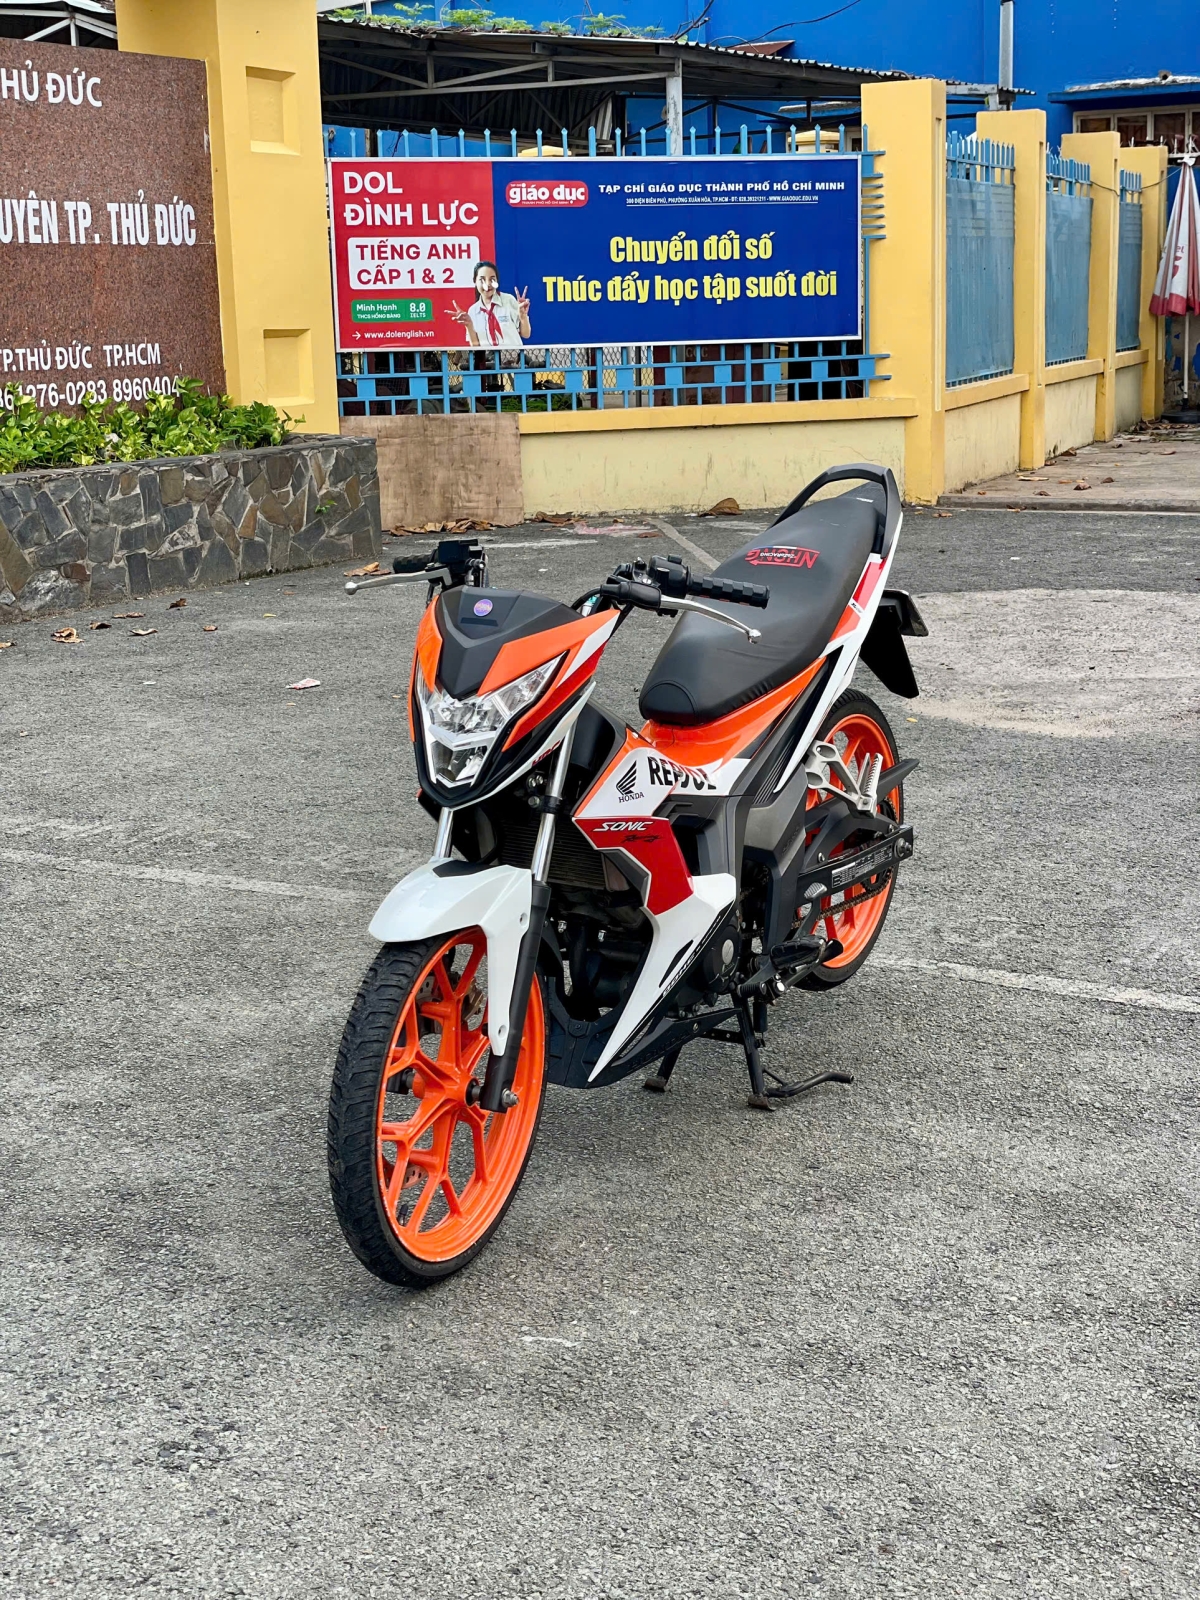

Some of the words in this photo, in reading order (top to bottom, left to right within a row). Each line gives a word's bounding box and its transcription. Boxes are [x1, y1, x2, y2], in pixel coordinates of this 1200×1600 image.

[0, 60, 39, 102] HỦ
[46, 67, 102, 108] ĐỨC
[343, 171, 403, 194] DOL
[509, 182, 550, 204] giáo
[552, 184, 585, 204] dục
[599, 184, 621, 195] TẠP
[624, 183, 644, 192] CHÍ
[648, 183, 675, 192] GIÁO
[679, 184, 702, 194] DỤC
[706, 182, 742, 191] THÀNH
[747, 180, 770, 191] PHỐ
[773, 180, 788, 190] HỒ
[792, 180, 812, 190] CHÍ
[816, 182, 844, 190] MINH
[0, 190, 58, 244] UYÊN
[64, 201, 100, 244] TP.
[107, 189, 149, 246] THỦ
[155, 195, 196, 246] ĐỨC
[344, 198, 413, 226] ĐÌNH
[422, 200, 479, 230] LỰC
[356, 239, 421, 260] TIẾNG
[427, 243, 471, 260] ANH
[610, 232, 697, 264] Chuyển
[704, 230, 740, 260] đổi
[746, 231, 775, 259] số
[357, 262, 401, 285] CẤP
[407, 269, 415, 284] 1
[422, 269, 435, 284] &
[442, 268, 454, 284] 2
[543, 275, 602, 302] Thúc
[608, 271, 649, 304] đẩy
[655, 275, 698, 306] học
[704, 272, 740, 305] tập
[746, 270, 796, 298] suốt
[802, 270, 837, 296] đời
[377, 304, 397, 312] Hạnh
[410, 302, 426, 312] 8.0
[364, 330, 434, 339] www.dolenglish.vn
[0, 340, 52, 372] P.THỦ
[55, 340, 92, 370] ĐỨC
[103, 343, 161, 367] TP.HCM
[618, 792, 644, 804] HONDA
[593, 822, 653, 832] SONIC
